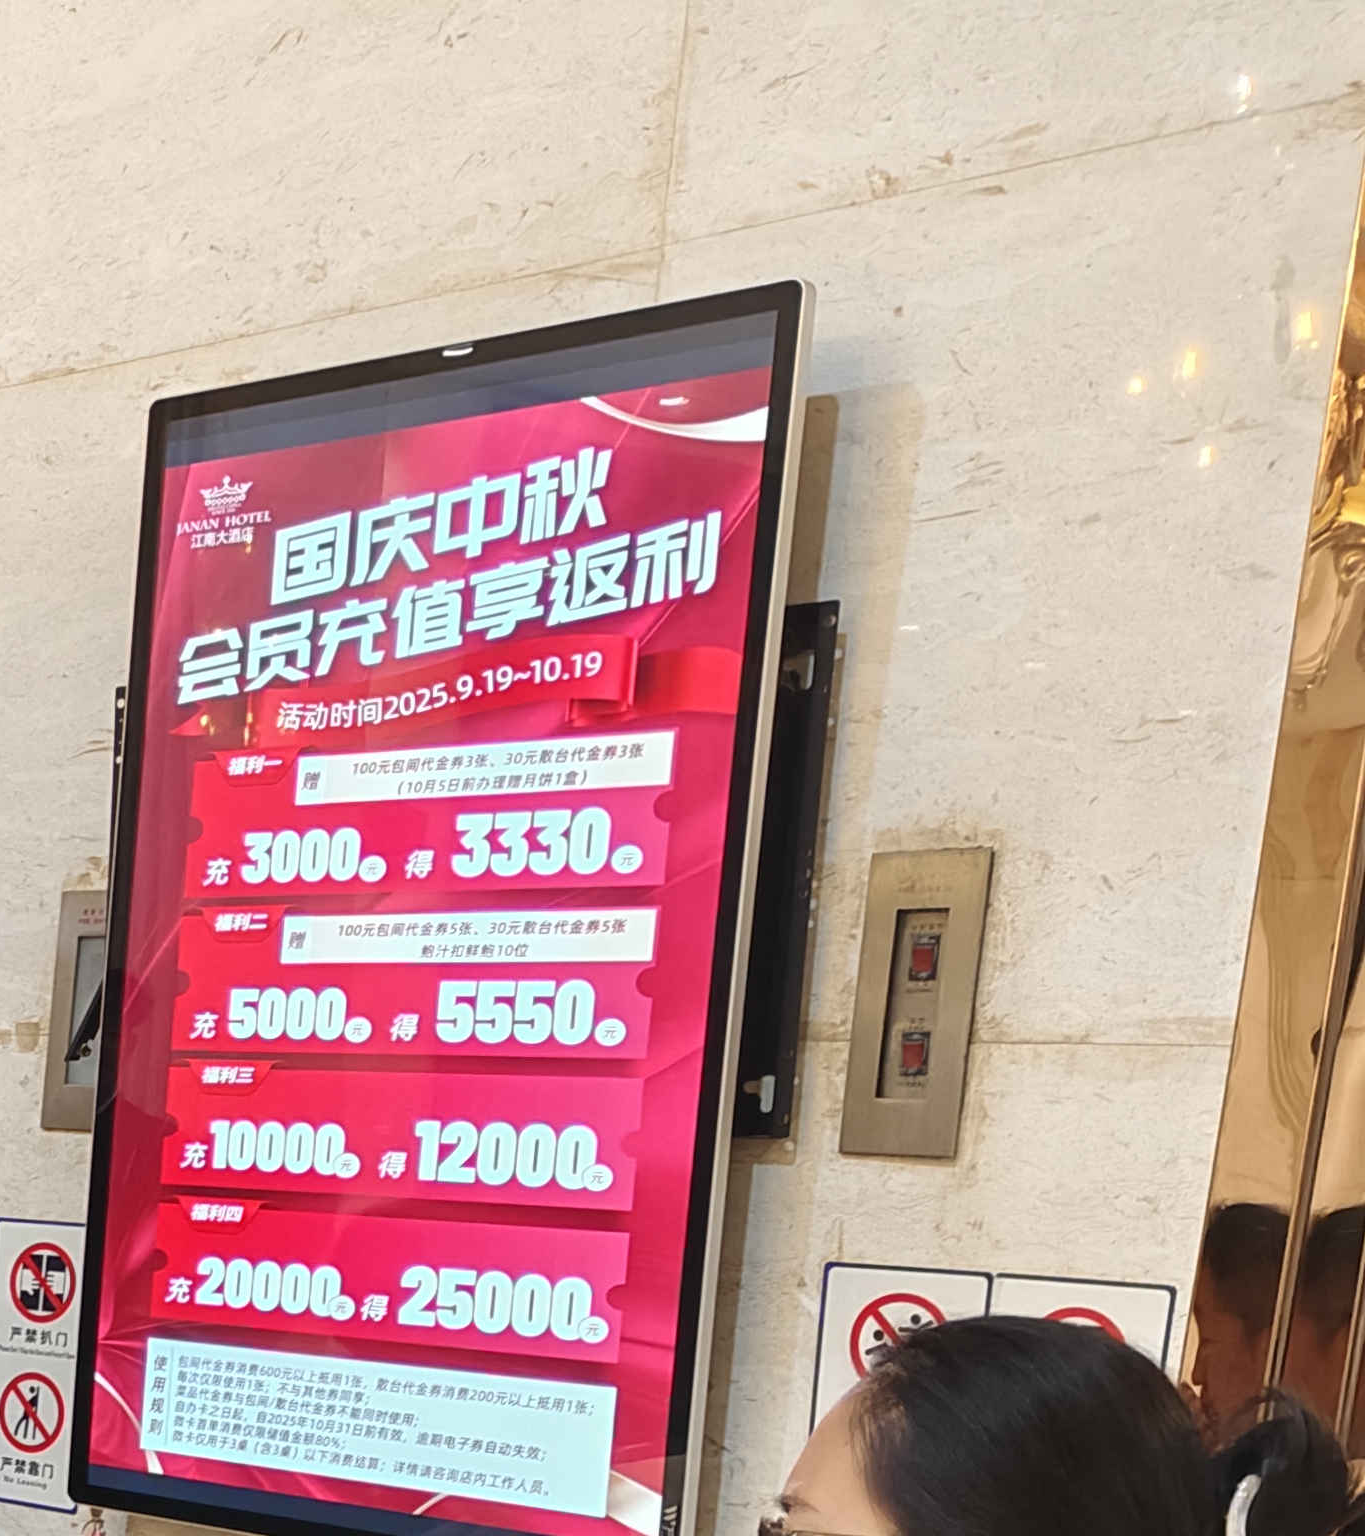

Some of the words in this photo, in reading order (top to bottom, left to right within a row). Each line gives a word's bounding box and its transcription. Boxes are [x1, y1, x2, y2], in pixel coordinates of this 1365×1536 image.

[224, 510, 272, 528] HOTEL
[270, 446, 613, 606] 国庆中秋
[190, 526, 254, 549] 江南大酒店
[177, 511, 723, 705] 会员充值享返利
[227, 755, 283, 776] 福利一
[301, 770, 321, 792] 赠
[214, 913, 269, 932] 福利二
[286, 930, 306, 950] 赠
[201, 1066, 254, 1085] 福利三
[190, 1204, 244, 1222] 福利四
[9, 1326, 68, 1348] 严禁扒门
[0, 1456, 54, 1480] 严禁靠门
[3, 1475, 14, 1483] No
